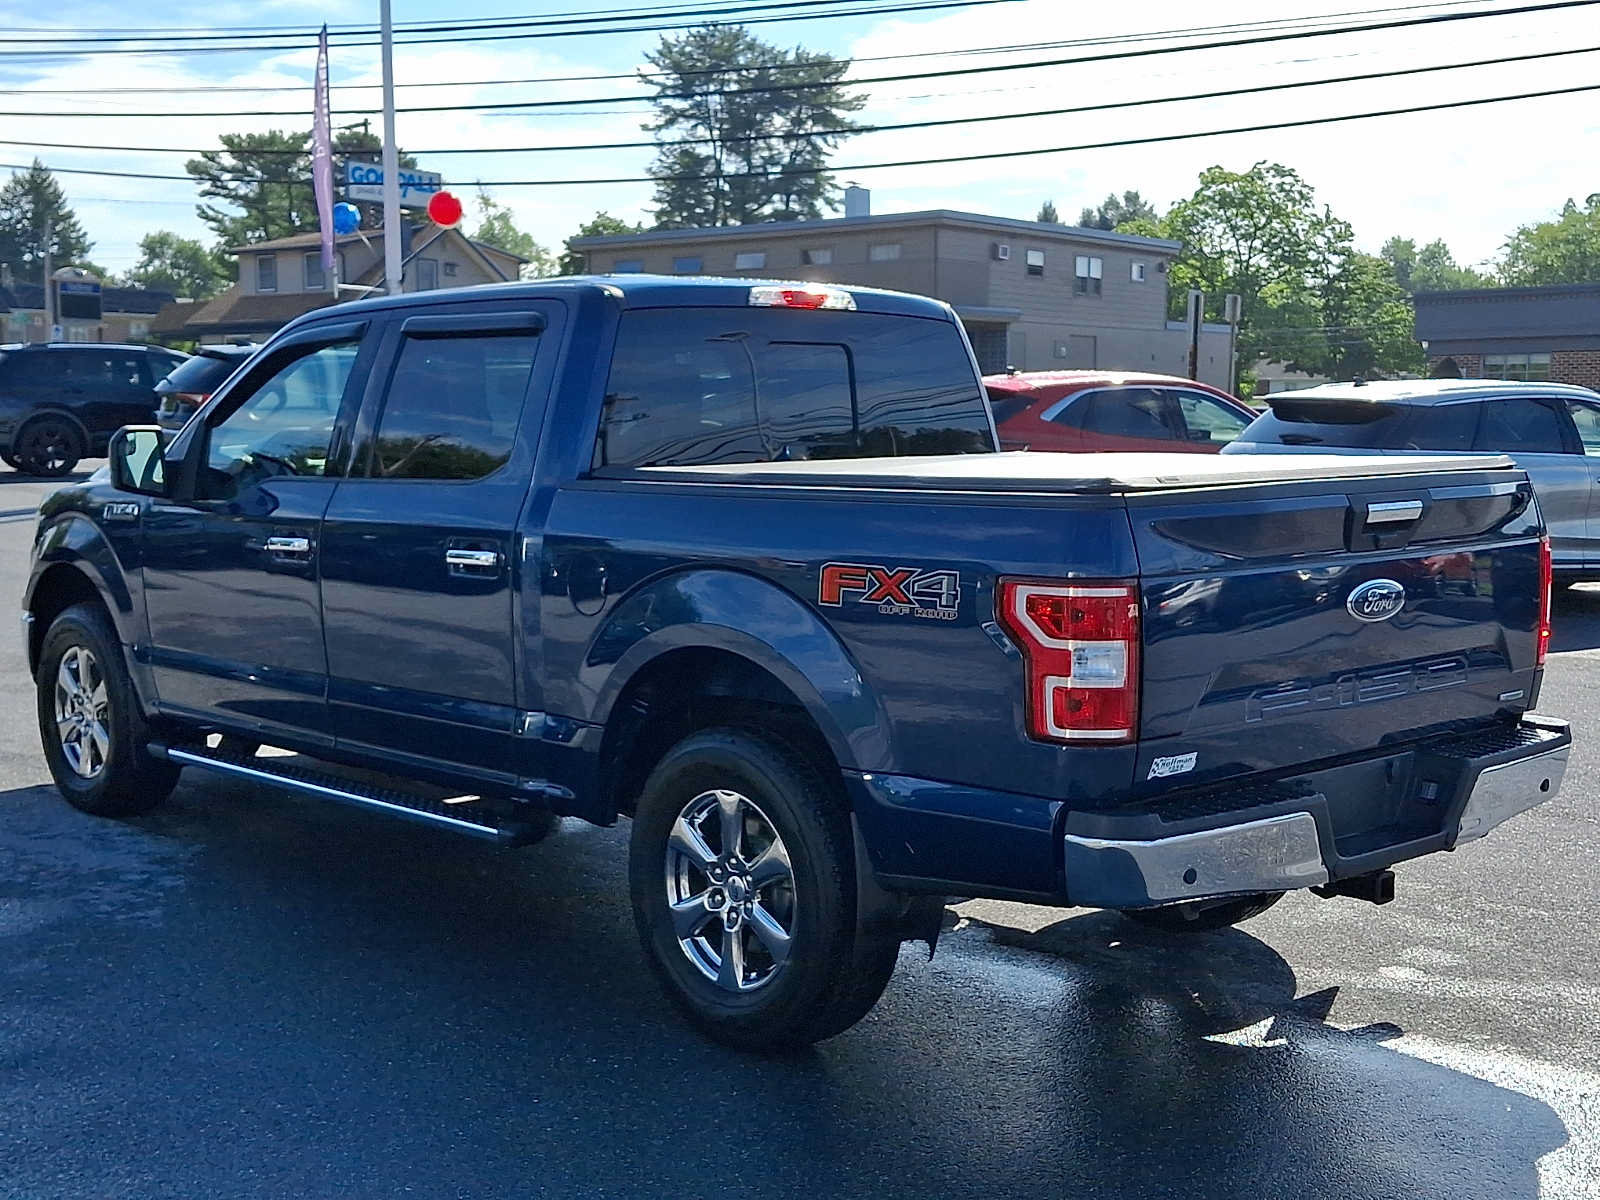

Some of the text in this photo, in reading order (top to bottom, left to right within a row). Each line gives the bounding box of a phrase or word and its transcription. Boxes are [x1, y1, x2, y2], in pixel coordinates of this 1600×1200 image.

[818, 562, 960, 610] FX4
[1363, 588, 1395, 613] Ford
[879, 605, 958, 620] OFF ROAD
[1245, 655, 1467, 722] F-150
